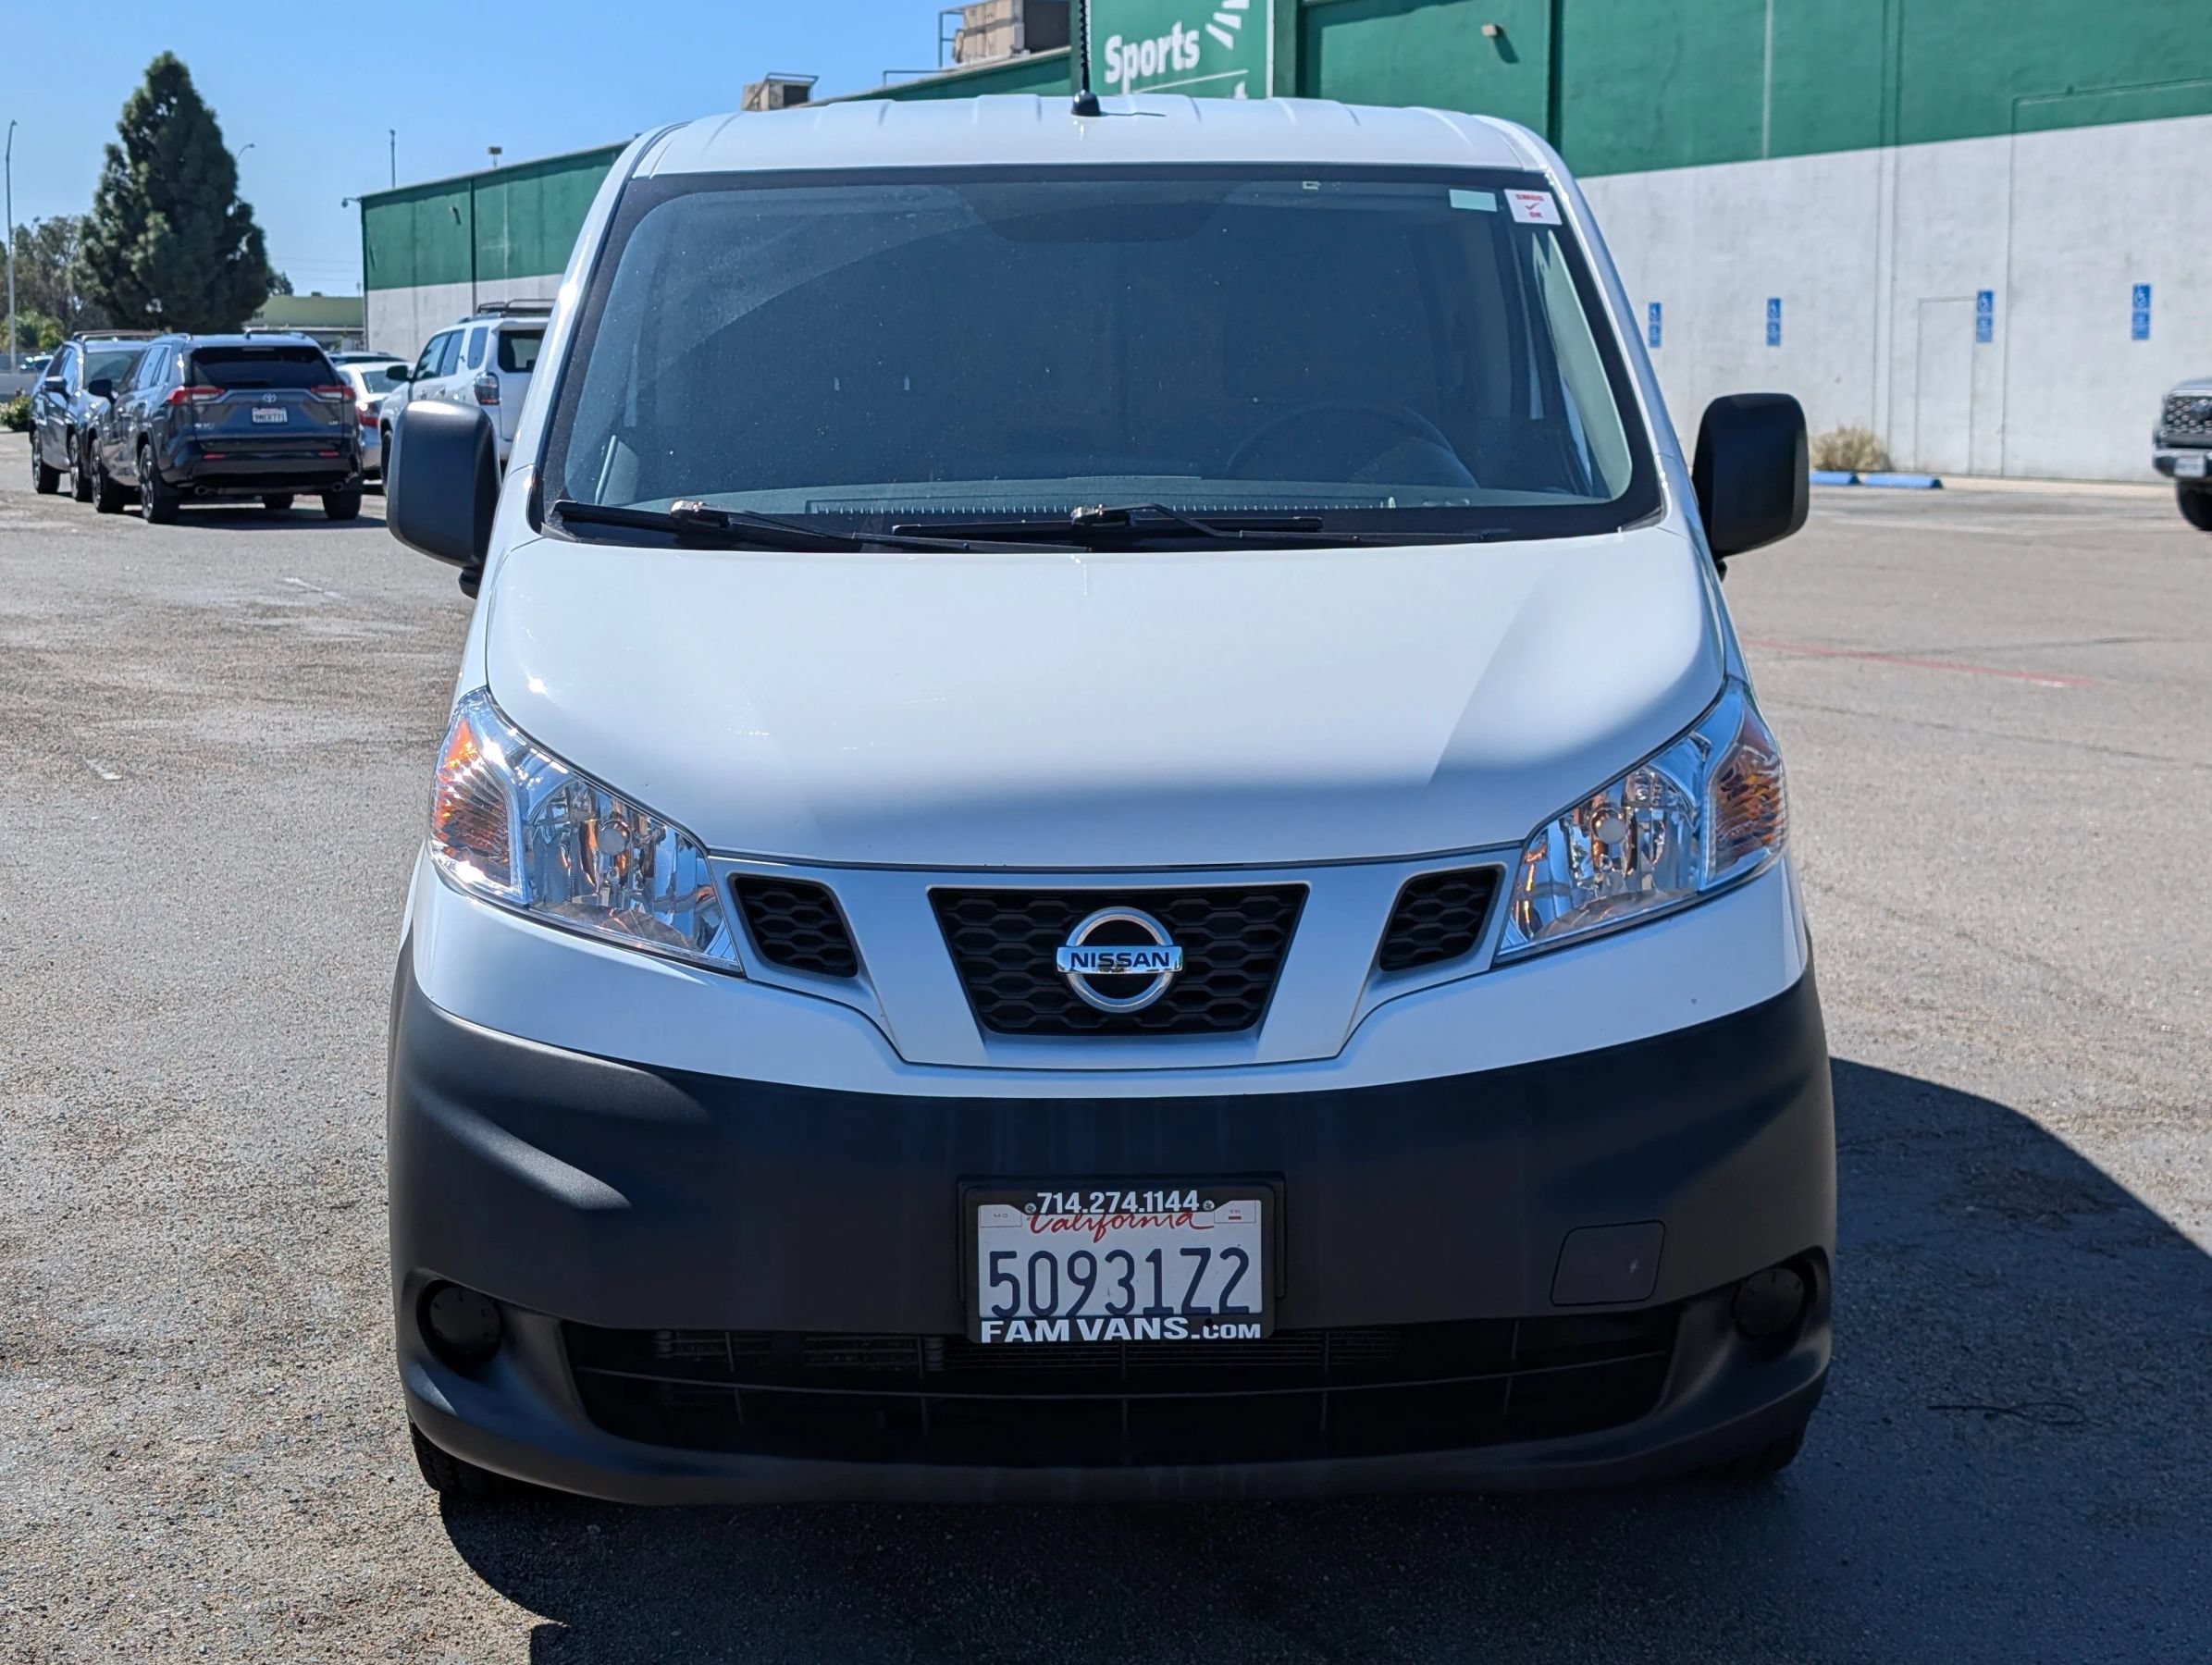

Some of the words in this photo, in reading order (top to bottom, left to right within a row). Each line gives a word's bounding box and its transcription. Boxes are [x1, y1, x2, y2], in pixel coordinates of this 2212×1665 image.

[1104, 21, 1200, 94] Sports
[1070, 952, 1169, 968] NISSAN
[1037, 1190, 1199, 1215] 714.274.1144
[1030, 1211, 1215, 1243] California
[989, 1247, 1249, 1318] 5093172
